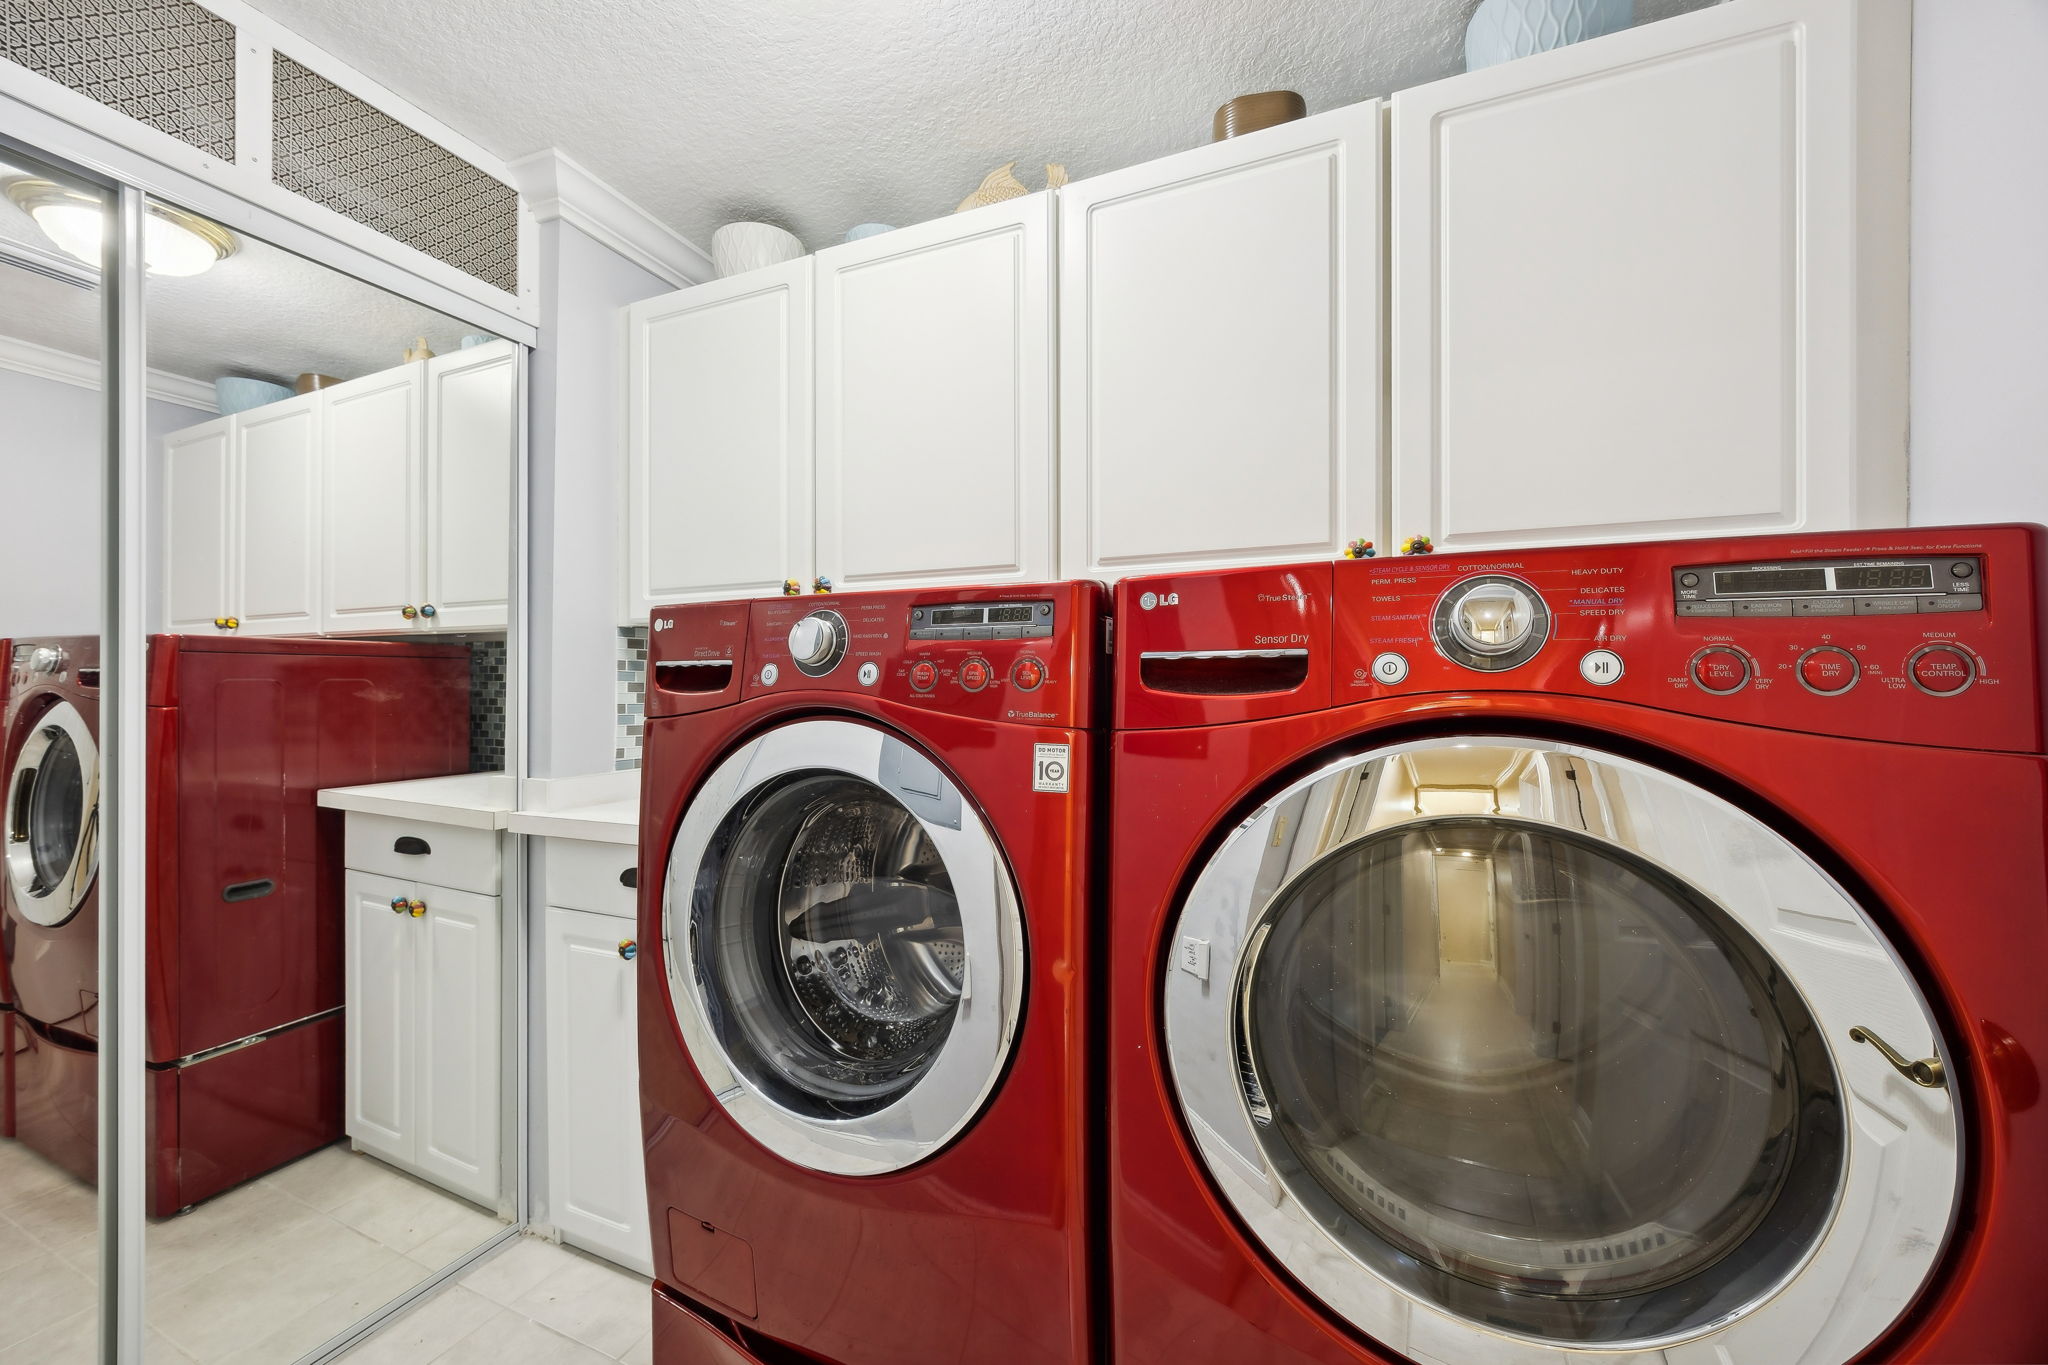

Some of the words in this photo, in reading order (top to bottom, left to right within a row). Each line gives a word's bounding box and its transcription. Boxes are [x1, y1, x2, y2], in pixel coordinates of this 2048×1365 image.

[1414, 564, 1438, 572] SENSOR
[1457, 563, 1525, 572] COTTON/NORMAL
[1600, 567, 1624, 575] DUTY
[1580, 586, 1625, 594] DELICATES
[1159, 592, 1179, 606] LG
[663, 619, 674, 630] LG
[1254, 634, 1288, 645] Sensor
[1290, 633, 1309, 645] Dry
[1609, 634, 1628, 642] DRY
[1016, 711, 1056, 719] TrueBalance
[1038, 760, 1065, 781] 10
